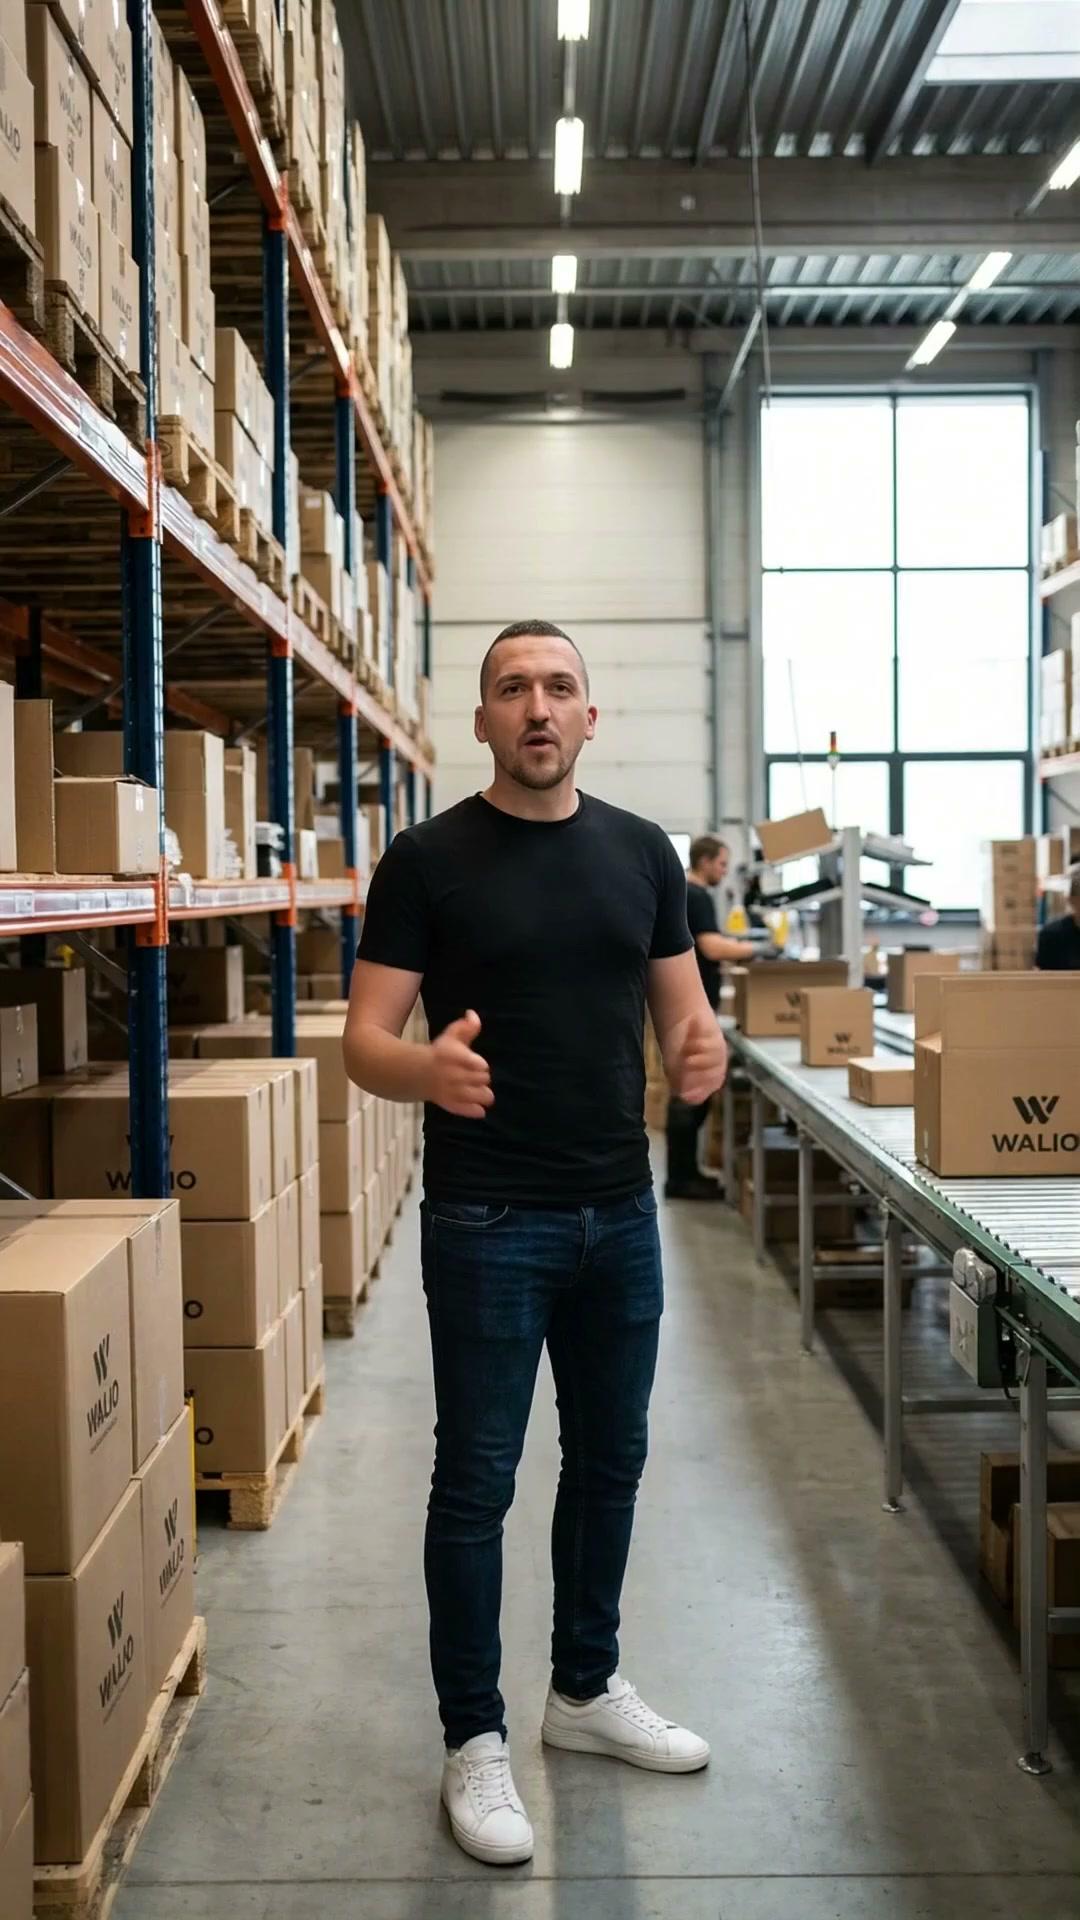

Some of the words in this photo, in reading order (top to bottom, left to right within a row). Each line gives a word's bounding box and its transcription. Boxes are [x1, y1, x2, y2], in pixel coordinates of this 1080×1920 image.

[992, 1132, 1080, 1153] WALIO
[105, 1170, 197, 1191] WIO
[87, 1379, 119, 1438] WALIO
[99, 1634, 134, 1709] WALIO
